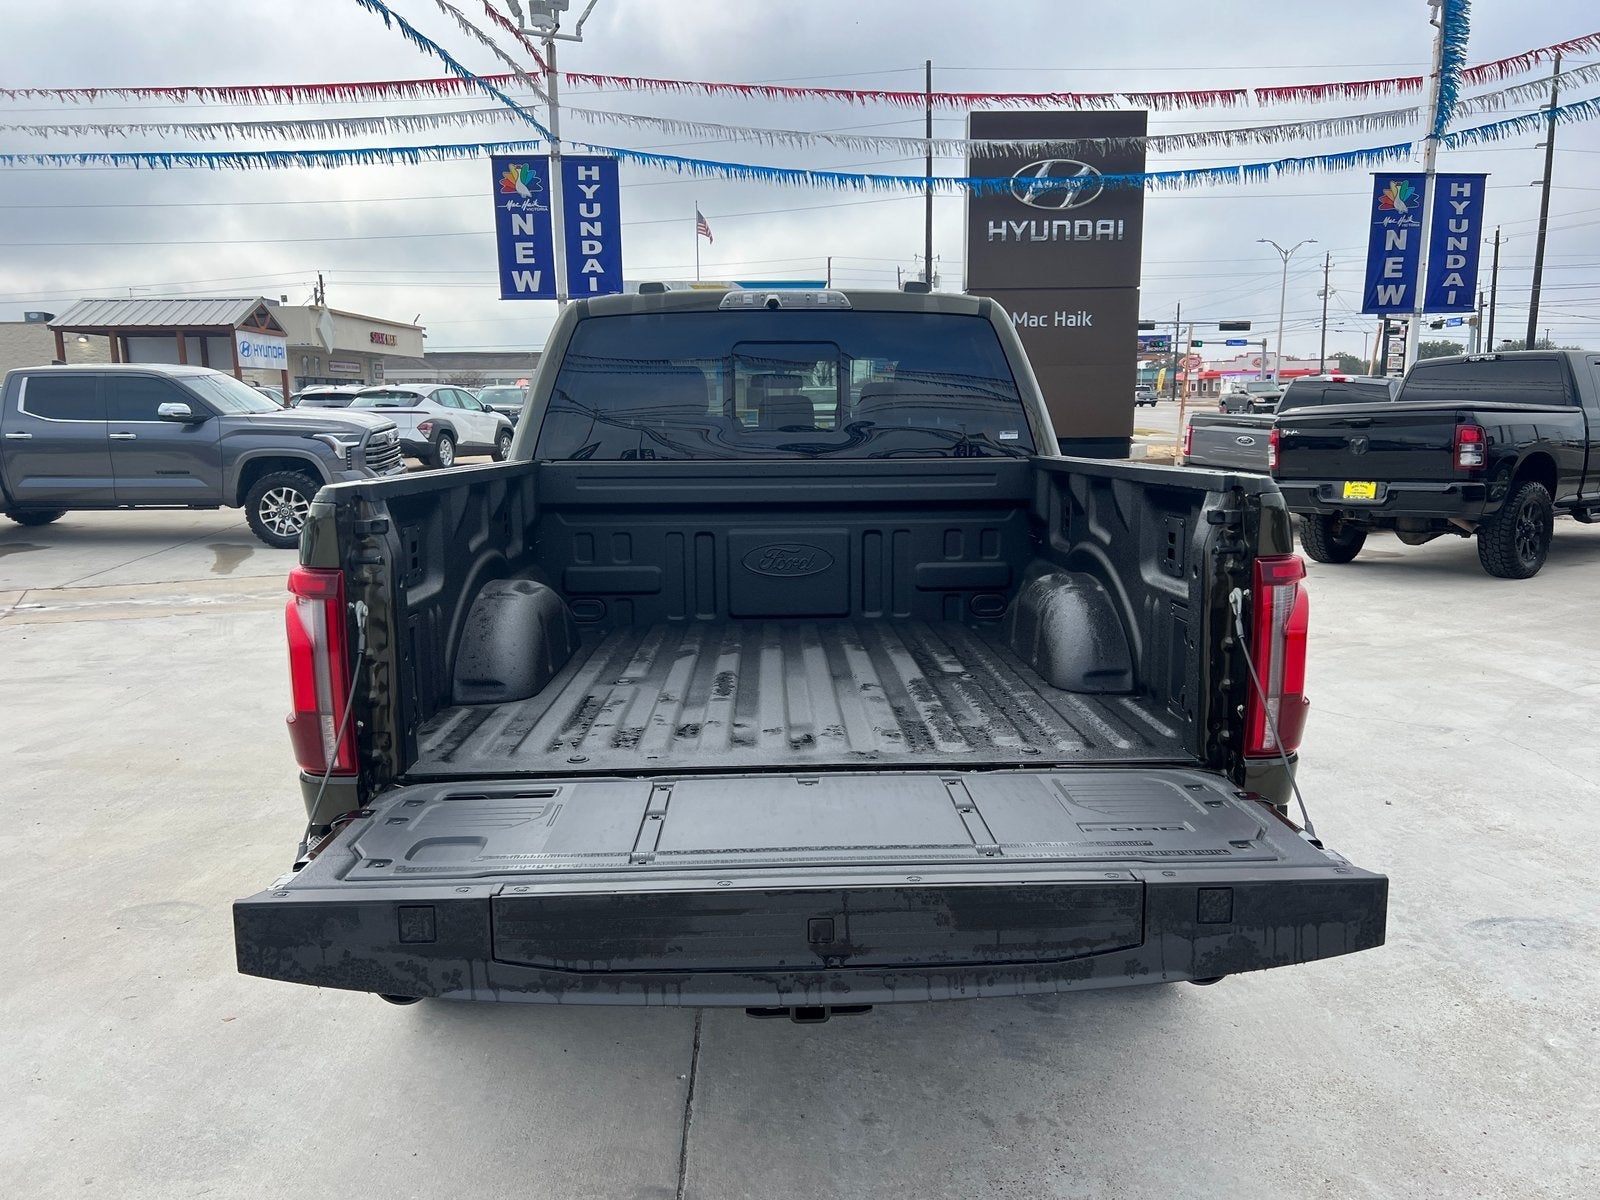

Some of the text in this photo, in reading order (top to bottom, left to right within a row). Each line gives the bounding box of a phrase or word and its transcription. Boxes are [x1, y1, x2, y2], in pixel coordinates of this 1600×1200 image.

[511, 213, 541, 293] NEW
[577, 165, 605, 292] HYUNDAI
[988, 219, 1124, 242] HYUNDAI
[1442, 182, 1471, 305] HYUNDAI
[1376, 229, 1408, 306] NEW
[1012, 311, 1092, 327] Mac Haik
[253, 344, 285, 359] HYUNDAI
[758, 546, 816, 571] Ford
